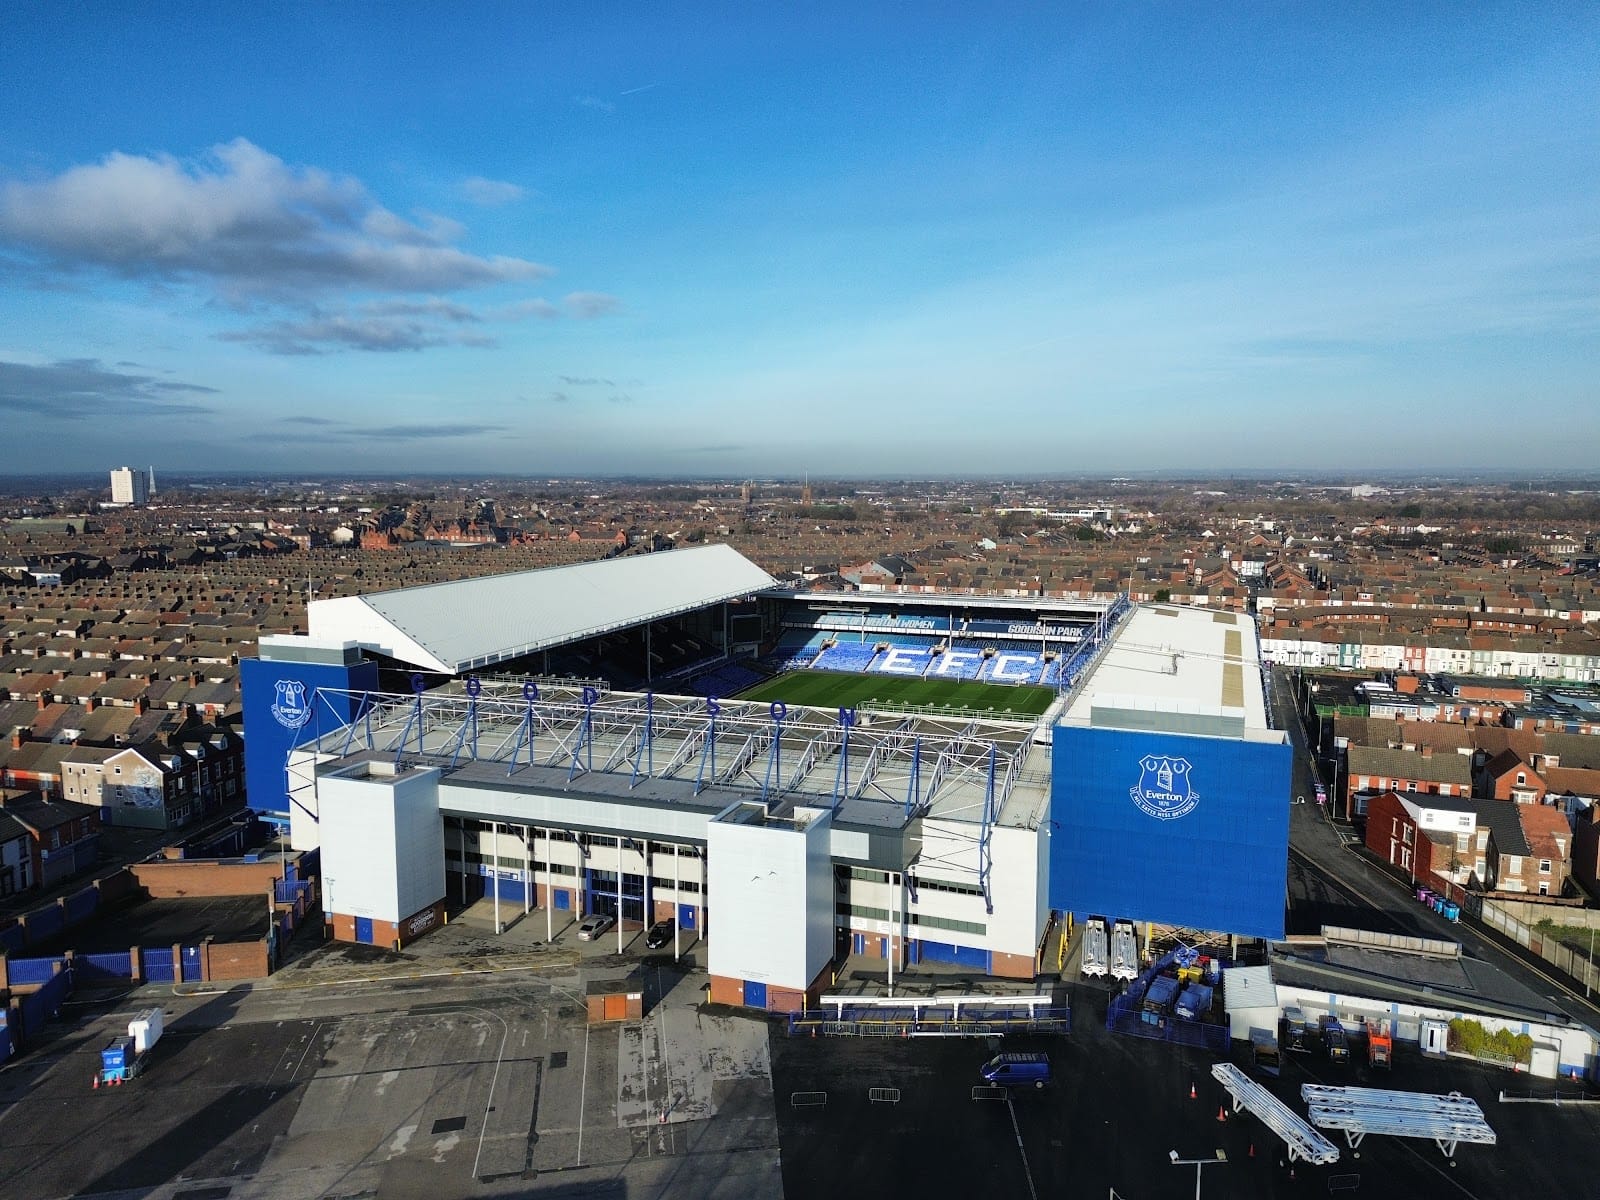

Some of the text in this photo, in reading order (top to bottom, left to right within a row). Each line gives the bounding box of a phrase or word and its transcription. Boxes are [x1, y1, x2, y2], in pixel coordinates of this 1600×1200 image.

[902, 619, 936, 629] WOMEN
[1057, 626, 1084, 637] PARK
[1146, 790, 1183, 801] Everton
